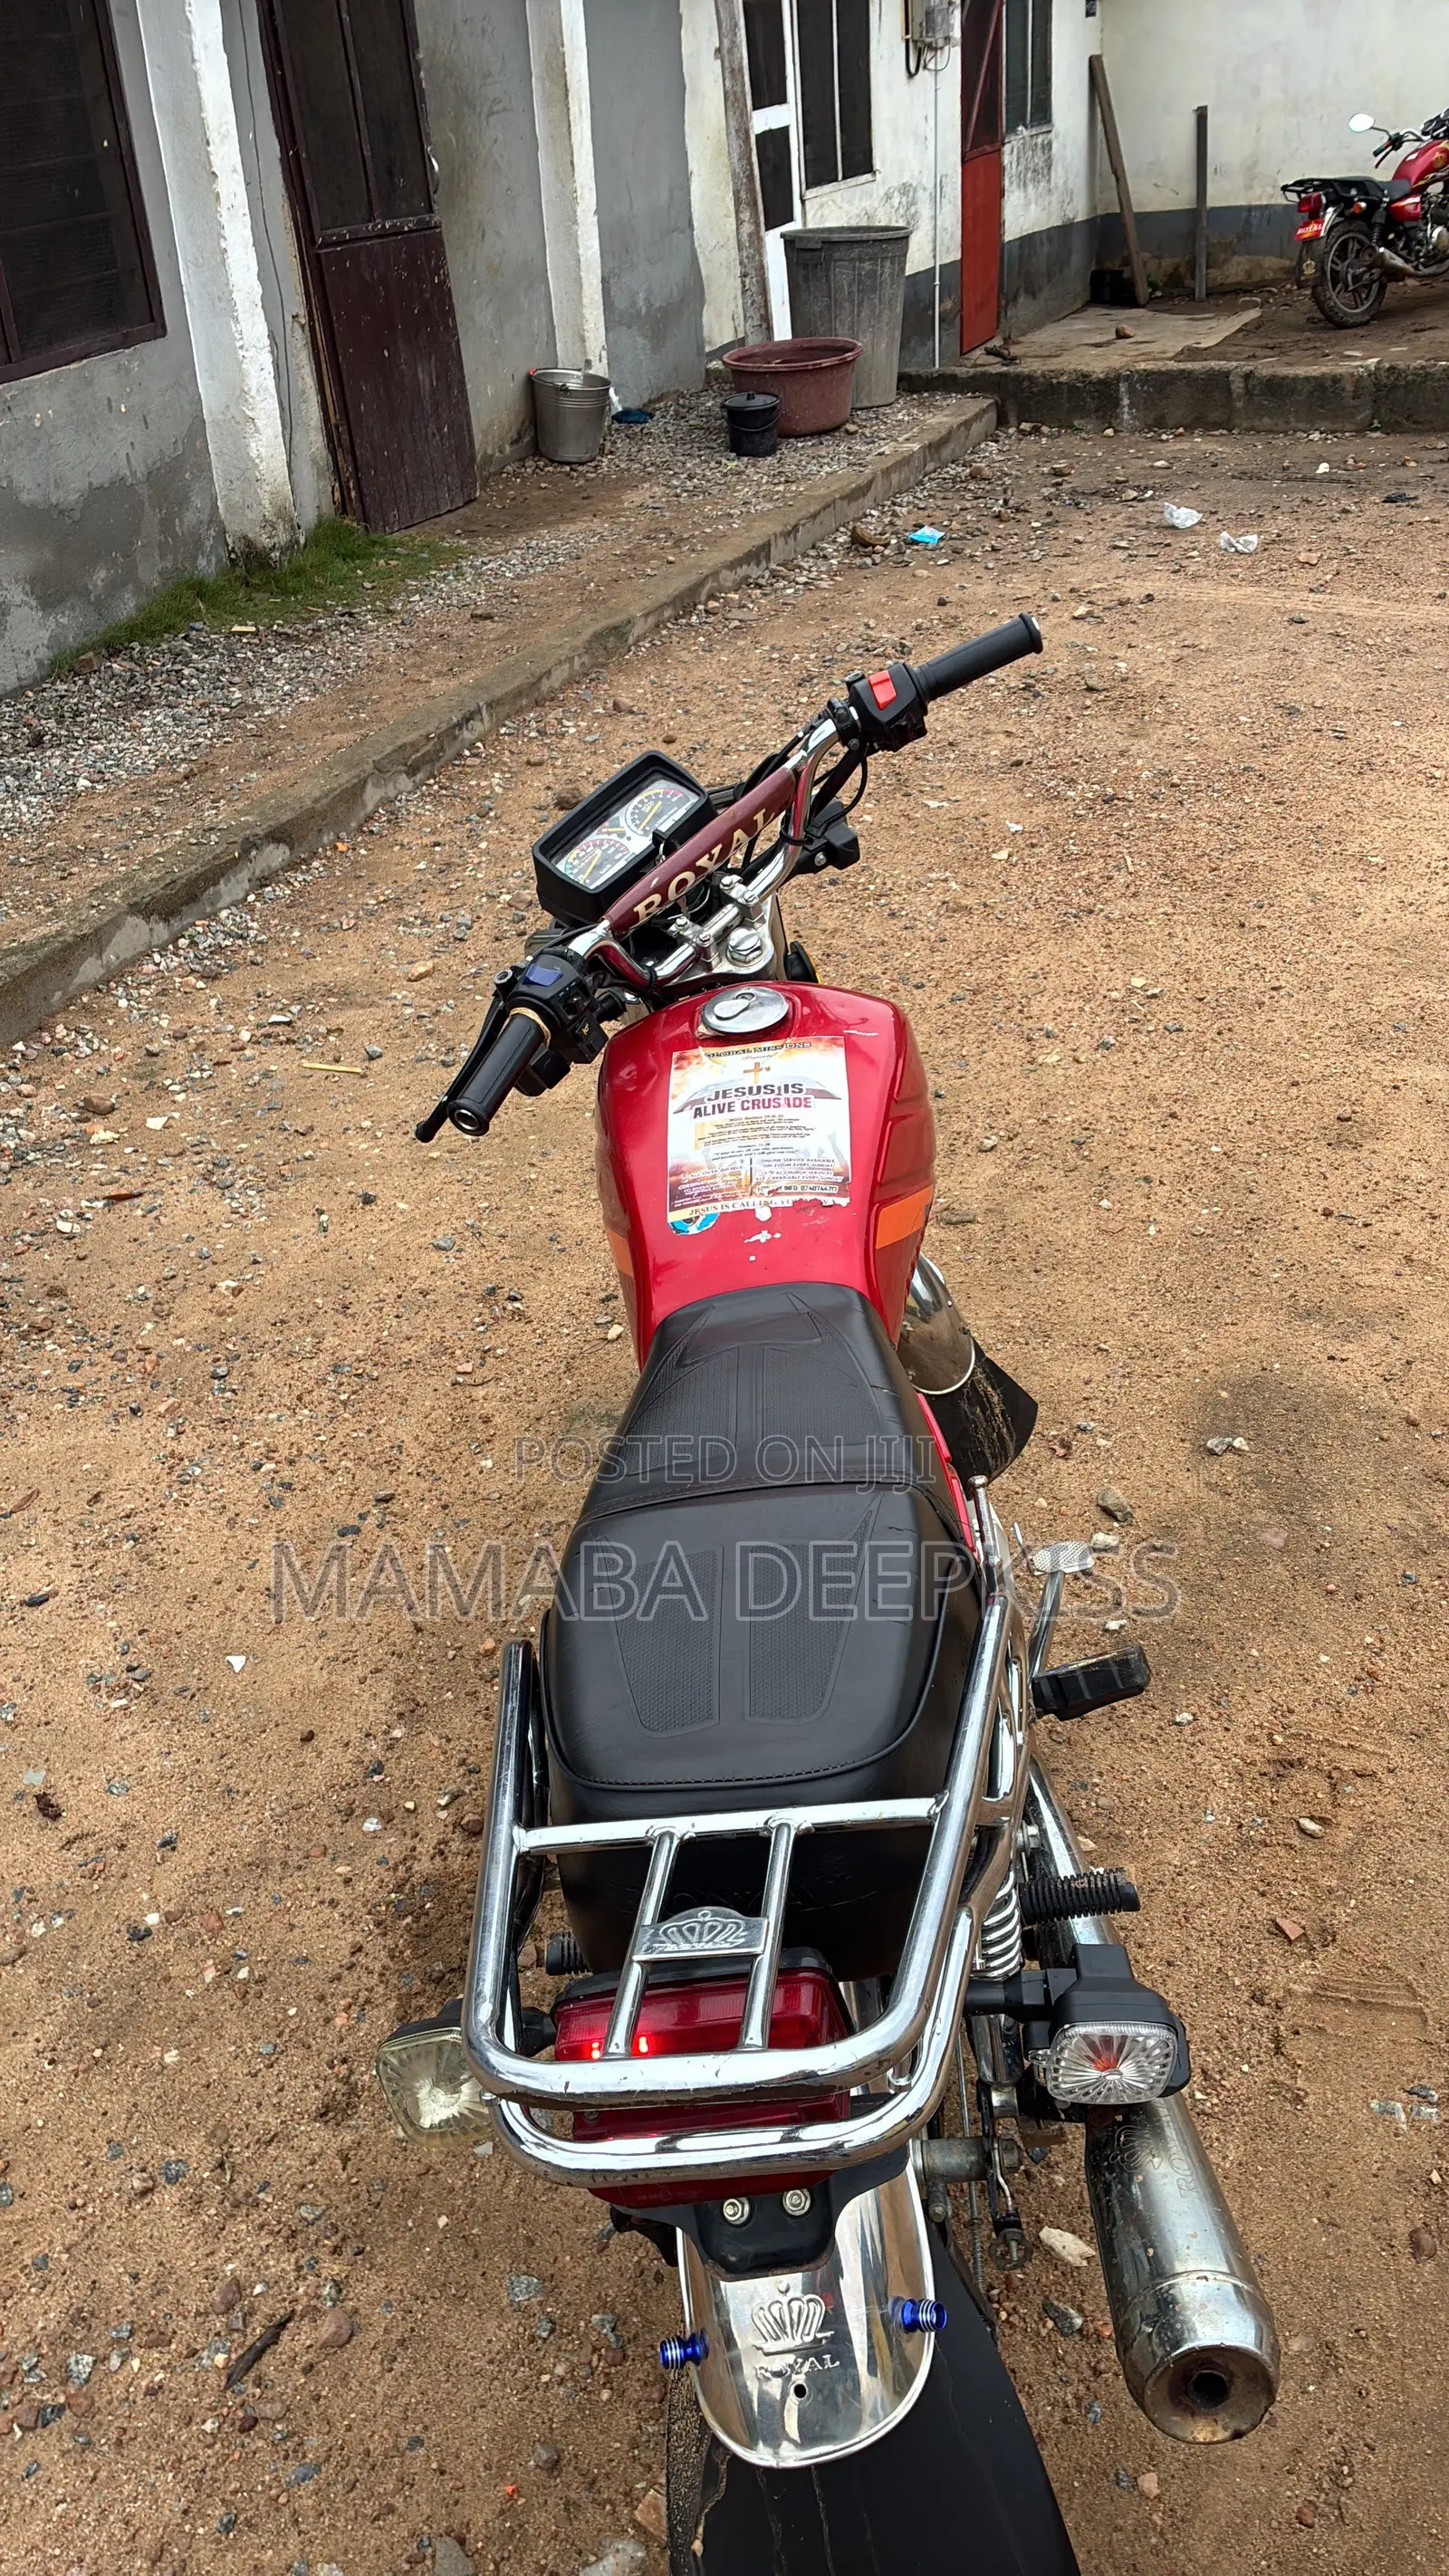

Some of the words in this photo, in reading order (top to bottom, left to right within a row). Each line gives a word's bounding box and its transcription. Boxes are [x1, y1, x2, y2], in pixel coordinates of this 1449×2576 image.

[633, 808, 775, 922] ROYAL
[706, 1084, 776, 1103] JESUS
[783, 1083, 804, 1095] IS
[693, 1101, 736, 1119] ALIVE
[740, 1096, 812, 1112] CRUSADE
[689, 1205, 718, 1216] JESUS
[753, 2354, 840, 2380] ROYAL
